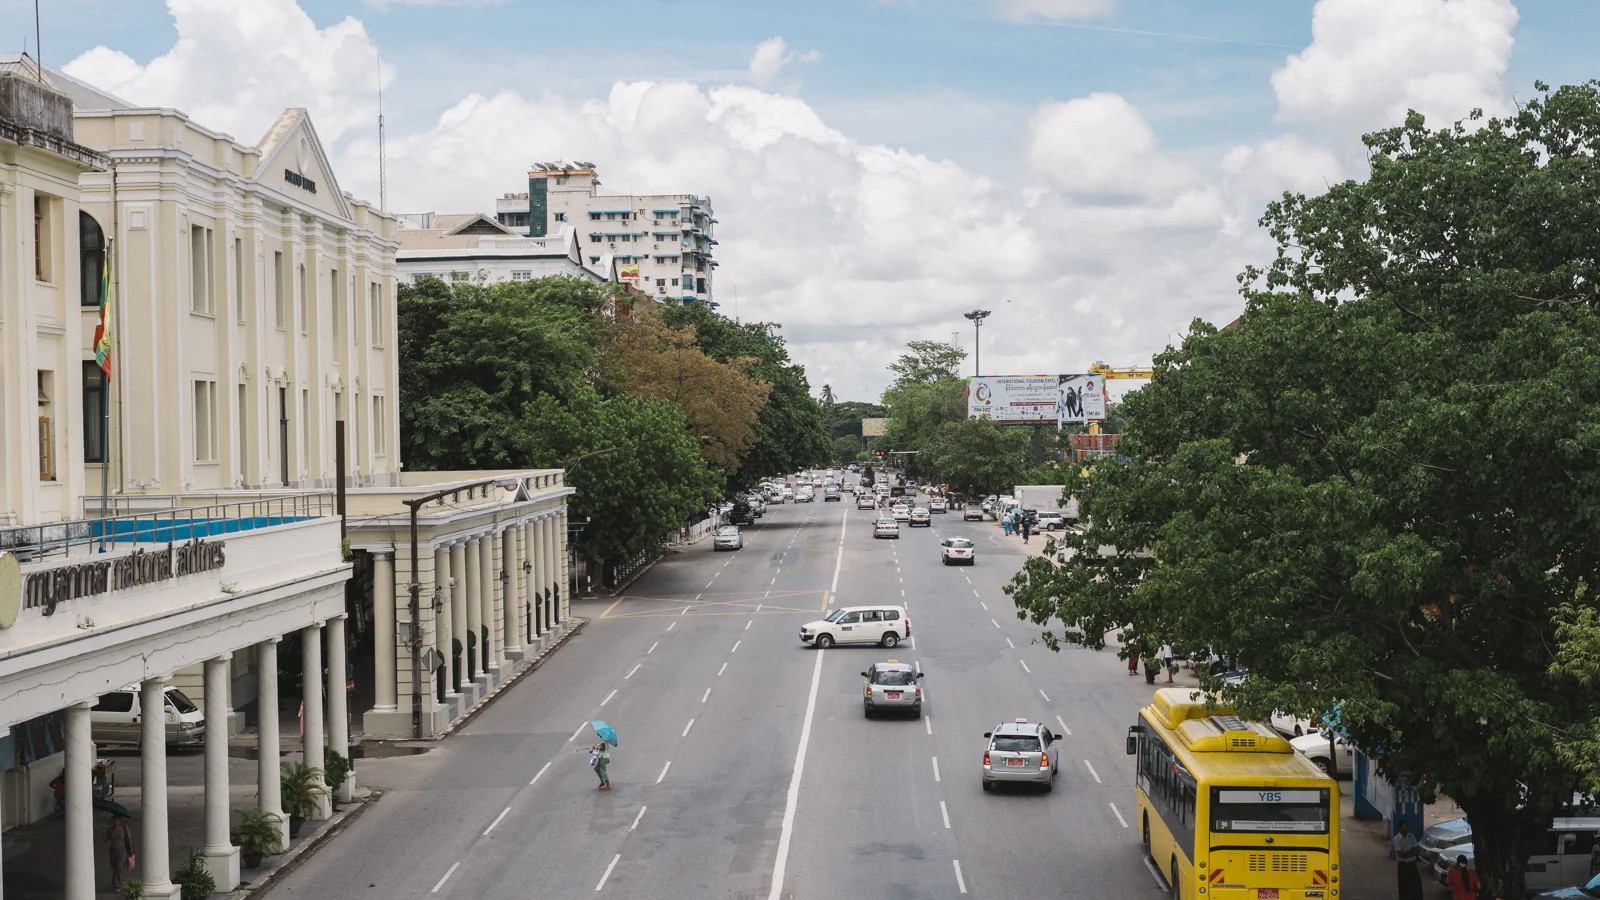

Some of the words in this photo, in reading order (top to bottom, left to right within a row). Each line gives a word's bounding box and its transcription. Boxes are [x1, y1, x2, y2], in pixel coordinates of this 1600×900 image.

[23, 559, 111, 617] myanmar
[111, 542, 174, 592] national
[175, 537, 226, 578] airlines
[1258, 792, 1282, 802] YBS
